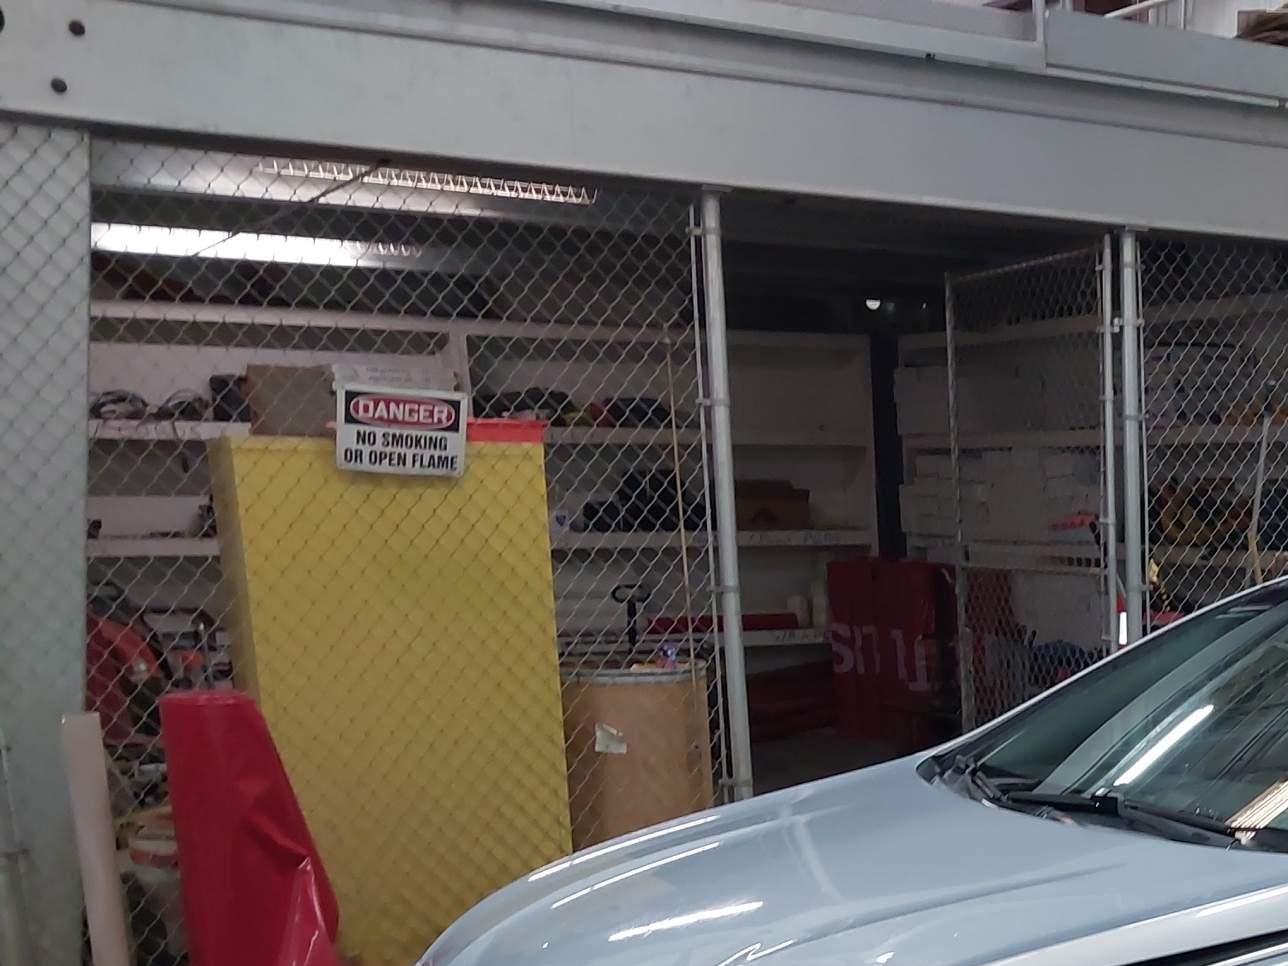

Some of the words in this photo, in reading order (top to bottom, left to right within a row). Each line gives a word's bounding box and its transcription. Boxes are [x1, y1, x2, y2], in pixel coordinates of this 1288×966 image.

[359, 400, 447, 423] DANGER
[356, 430, 376, 446] NO
[382, 432, 447, 451] SMOKING
[344, 448, 363, 464] OR
[369, 450, 406, 467] OPEN
[412, 453, 457, 471] FLAME
